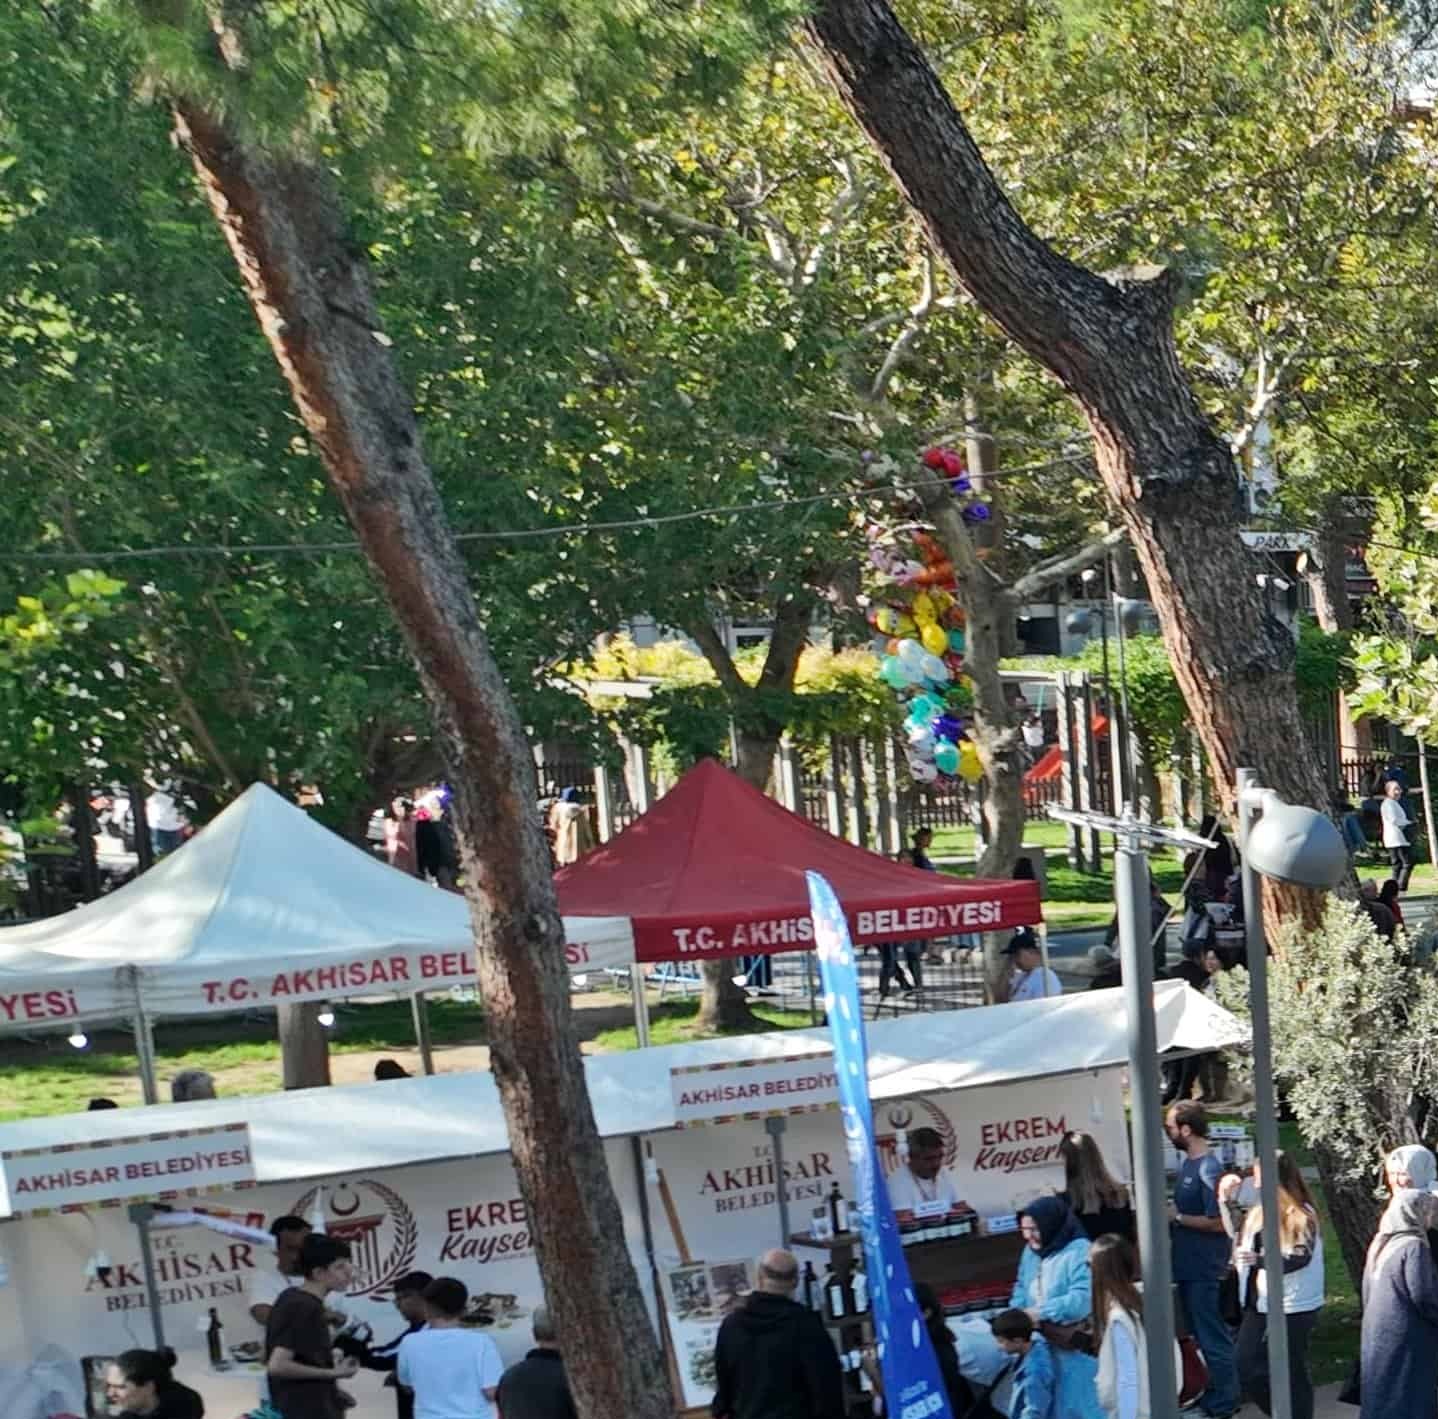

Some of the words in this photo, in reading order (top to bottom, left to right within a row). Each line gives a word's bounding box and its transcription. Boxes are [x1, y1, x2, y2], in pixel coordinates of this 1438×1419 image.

[673, 928, 723, 951] T.C.
[202, 979, 258, 1004] T.C.
[680, 1084, 760, 1107] AKHİSAR
[764, 1072, 839, 1096] BELEDİY
[981, 1115, 1066, 1146] EKREM
[15, 1165, 121, 1194] AKHİSAR
[125, 1146, 251, 1180] BELEDİYESİ
[446, 1198, 529, 1232] EKRE
